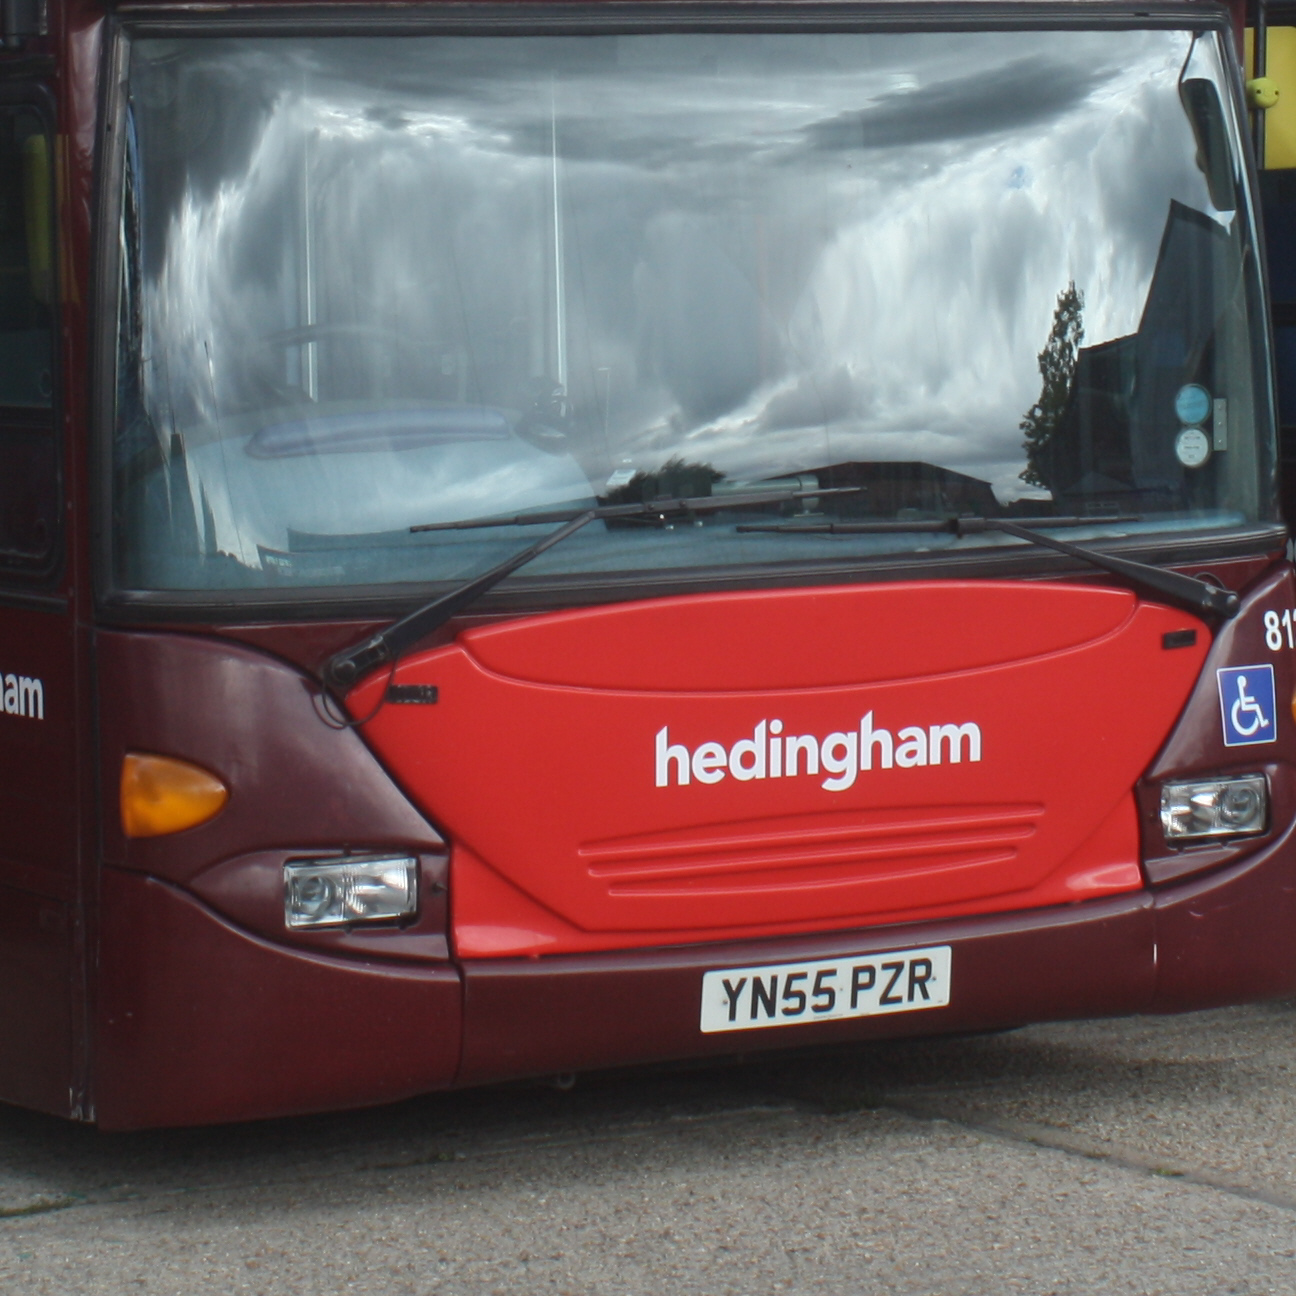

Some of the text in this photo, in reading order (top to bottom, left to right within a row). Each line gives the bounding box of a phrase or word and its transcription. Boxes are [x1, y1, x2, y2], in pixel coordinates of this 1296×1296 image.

[655, 710, 981, 792] hedingham
[722, 957, 933, 1022] YN55 PZR
